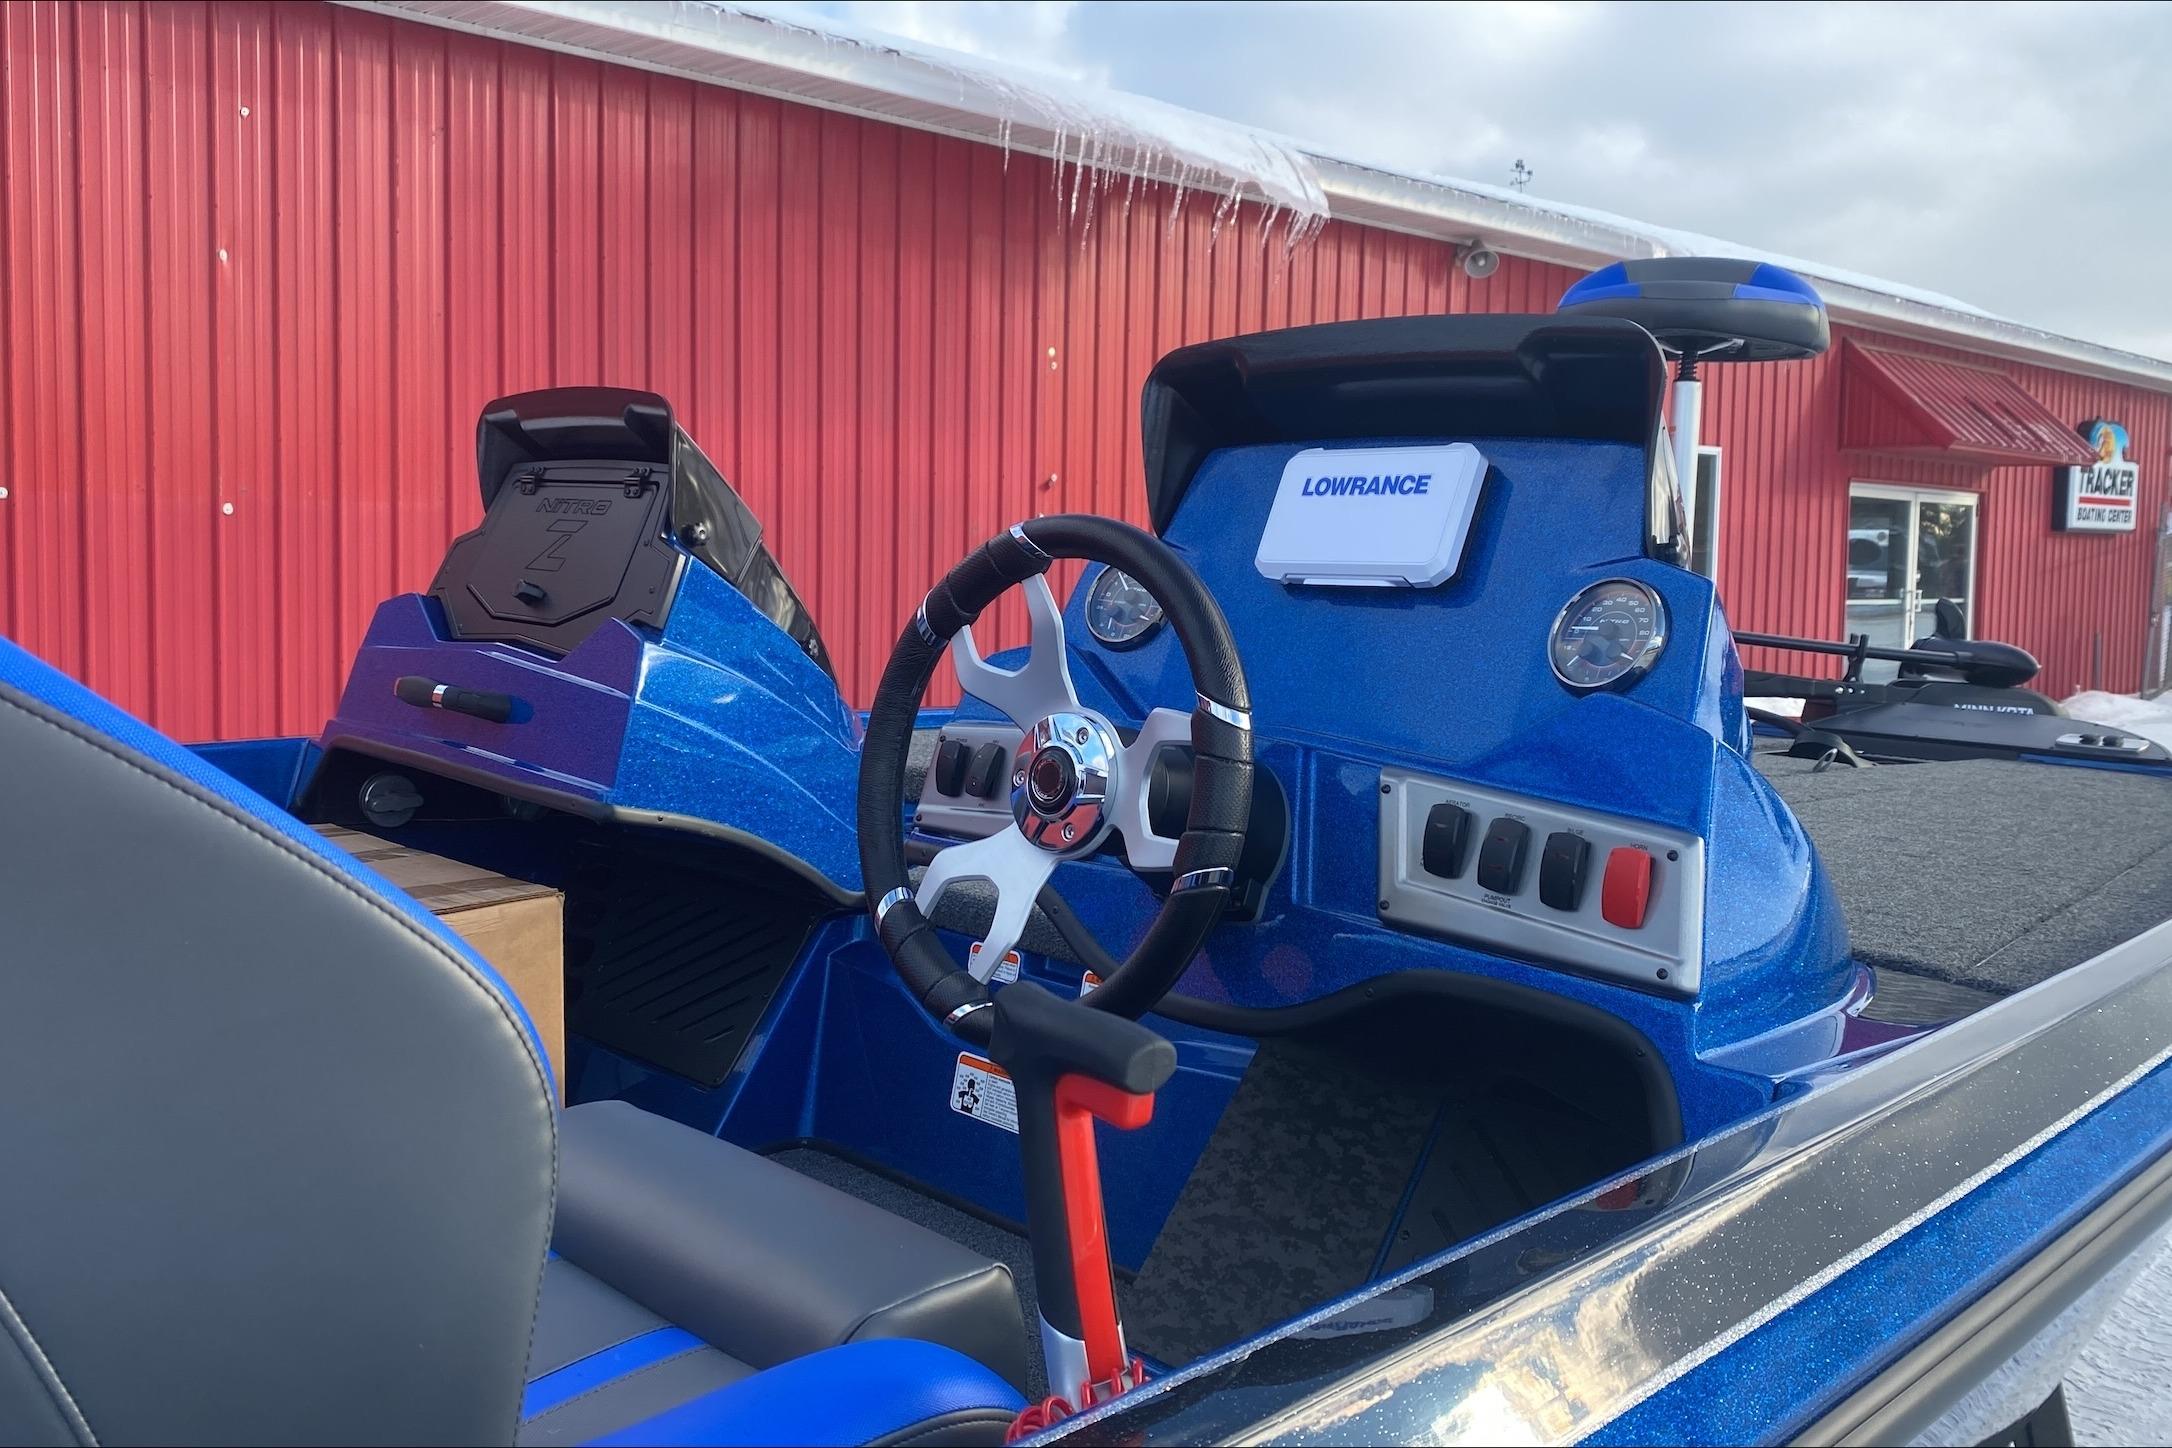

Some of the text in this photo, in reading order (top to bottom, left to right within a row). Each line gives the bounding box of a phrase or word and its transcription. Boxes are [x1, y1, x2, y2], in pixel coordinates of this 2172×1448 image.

[1302, 475, 1432, 497] LOWRANCE
[2079, 466, 2134, 497] TRACKER
[536, 497, 614, 516] NITRO
[2077, 507, 2132, 522] BOATING CENTER
[1630, 842, 1649, 851] HORN
